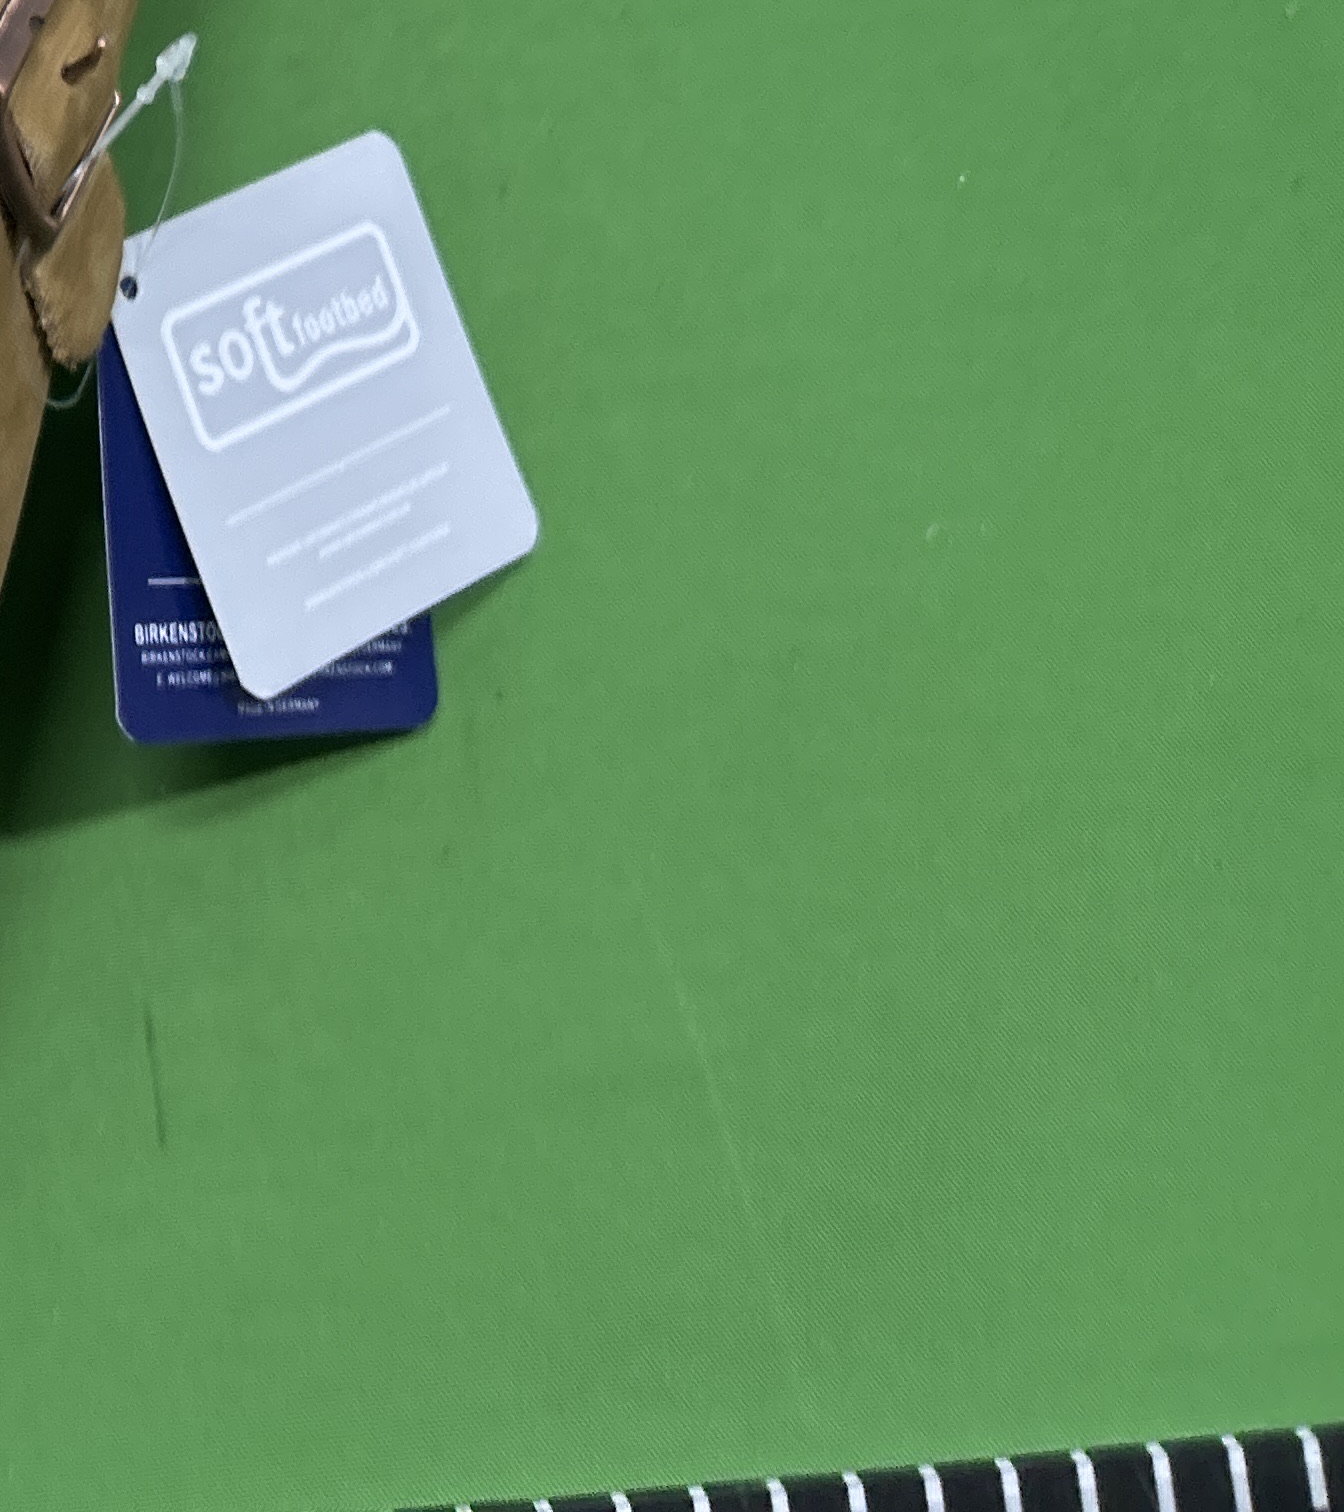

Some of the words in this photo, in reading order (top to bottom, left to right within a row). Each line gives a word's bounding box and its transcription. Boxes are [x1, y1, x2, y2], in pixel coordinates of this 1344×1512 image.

[189, 294, 297, 395] soft
[293, 275, 388, 345] footbed
[134, 620, 223, 646] BIRKENSTO
